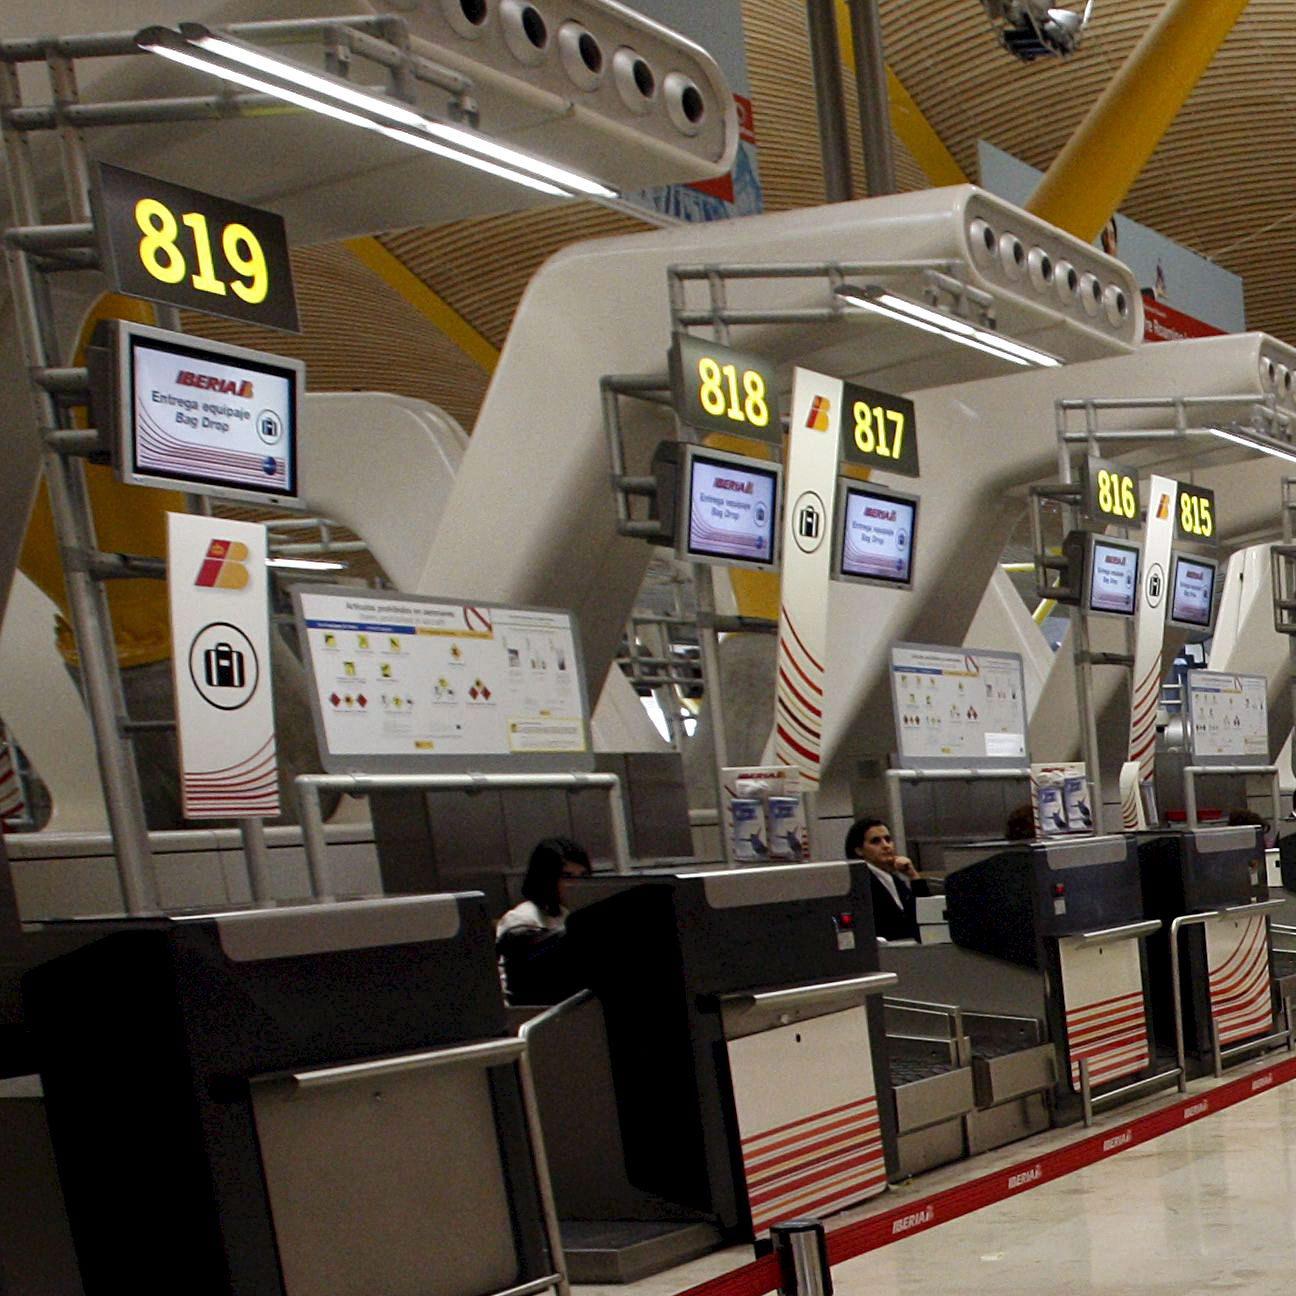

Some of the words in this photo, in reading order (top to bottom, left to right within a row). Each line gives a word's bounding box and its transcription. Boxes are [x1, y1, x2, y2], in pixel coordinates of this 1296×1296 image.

[134, 198, 268, 304] 819
[152, 390, 198, 411] Entrega
[176, 371, 237, 395] IBERIA
[699, 357, 769, 427] 818
[176, 411, 198, 429] Bag
[201, 416, 230, 434] Drop
[853, 401, 904, 460] 817
[1097, 469, 1136, 519] 816
[1180, 492, 1213, 537] 815
[892, 1210, 928, 1234] IBERIA
